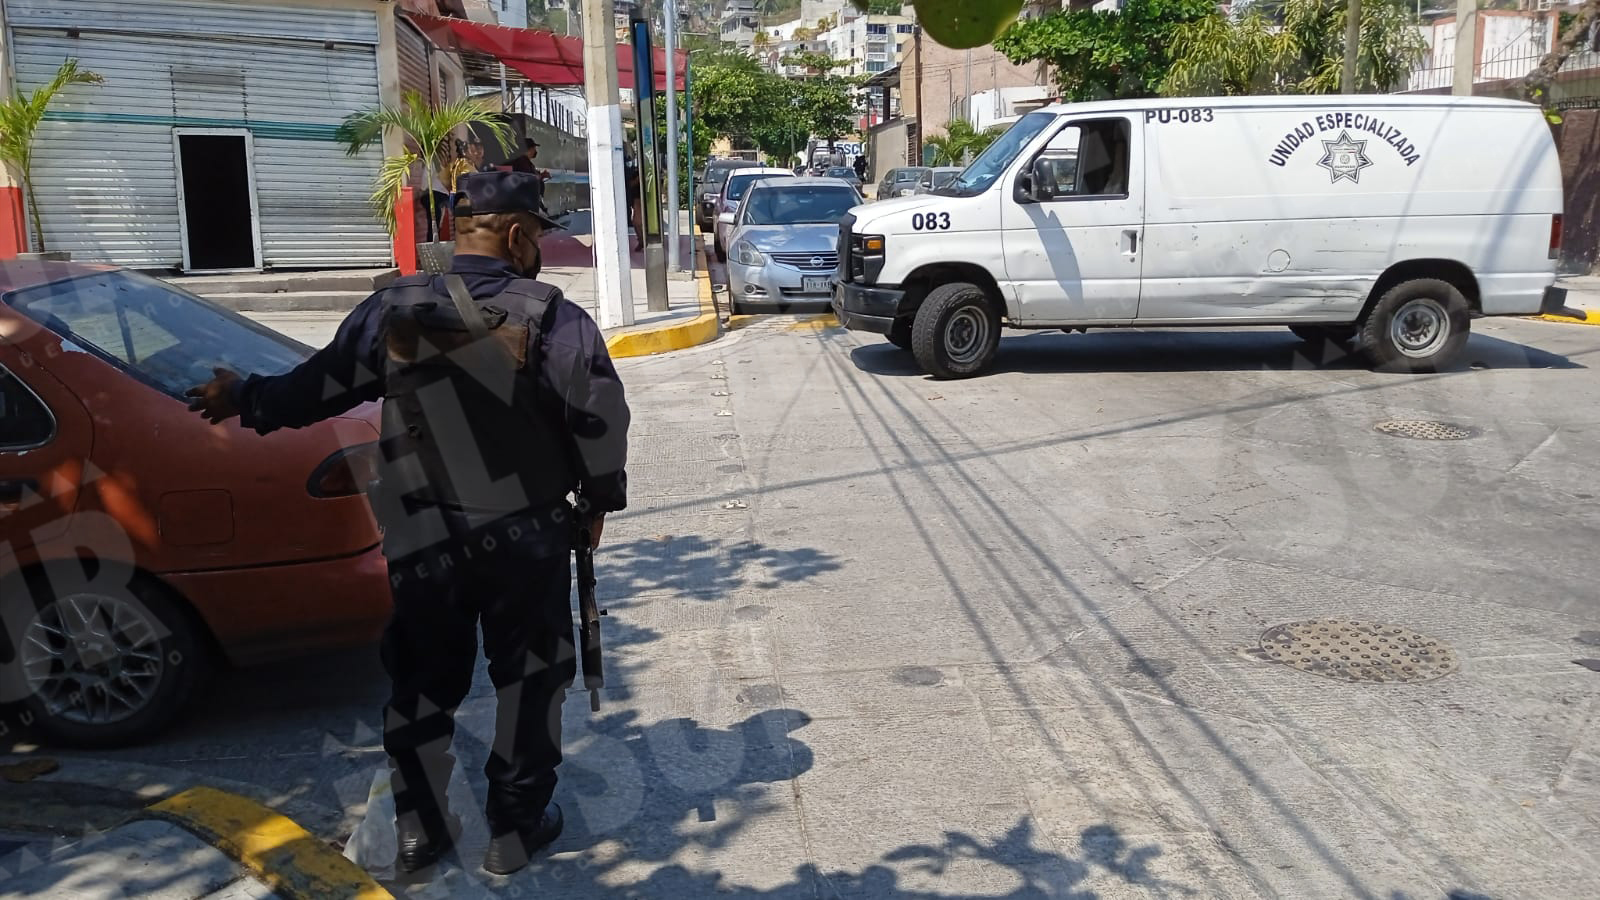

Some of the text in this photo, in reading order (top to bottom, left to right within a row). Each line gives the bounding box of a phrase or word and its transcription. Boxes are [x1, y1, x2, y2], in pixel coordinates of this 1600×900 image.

[1145, 108, 1214, 124] PU-083
[1269, 121, 1315, 167] UNIDAD
[1315, 112, 1421, 167] ESPECIALIZADA
[912, 212, 951, 231] 083
